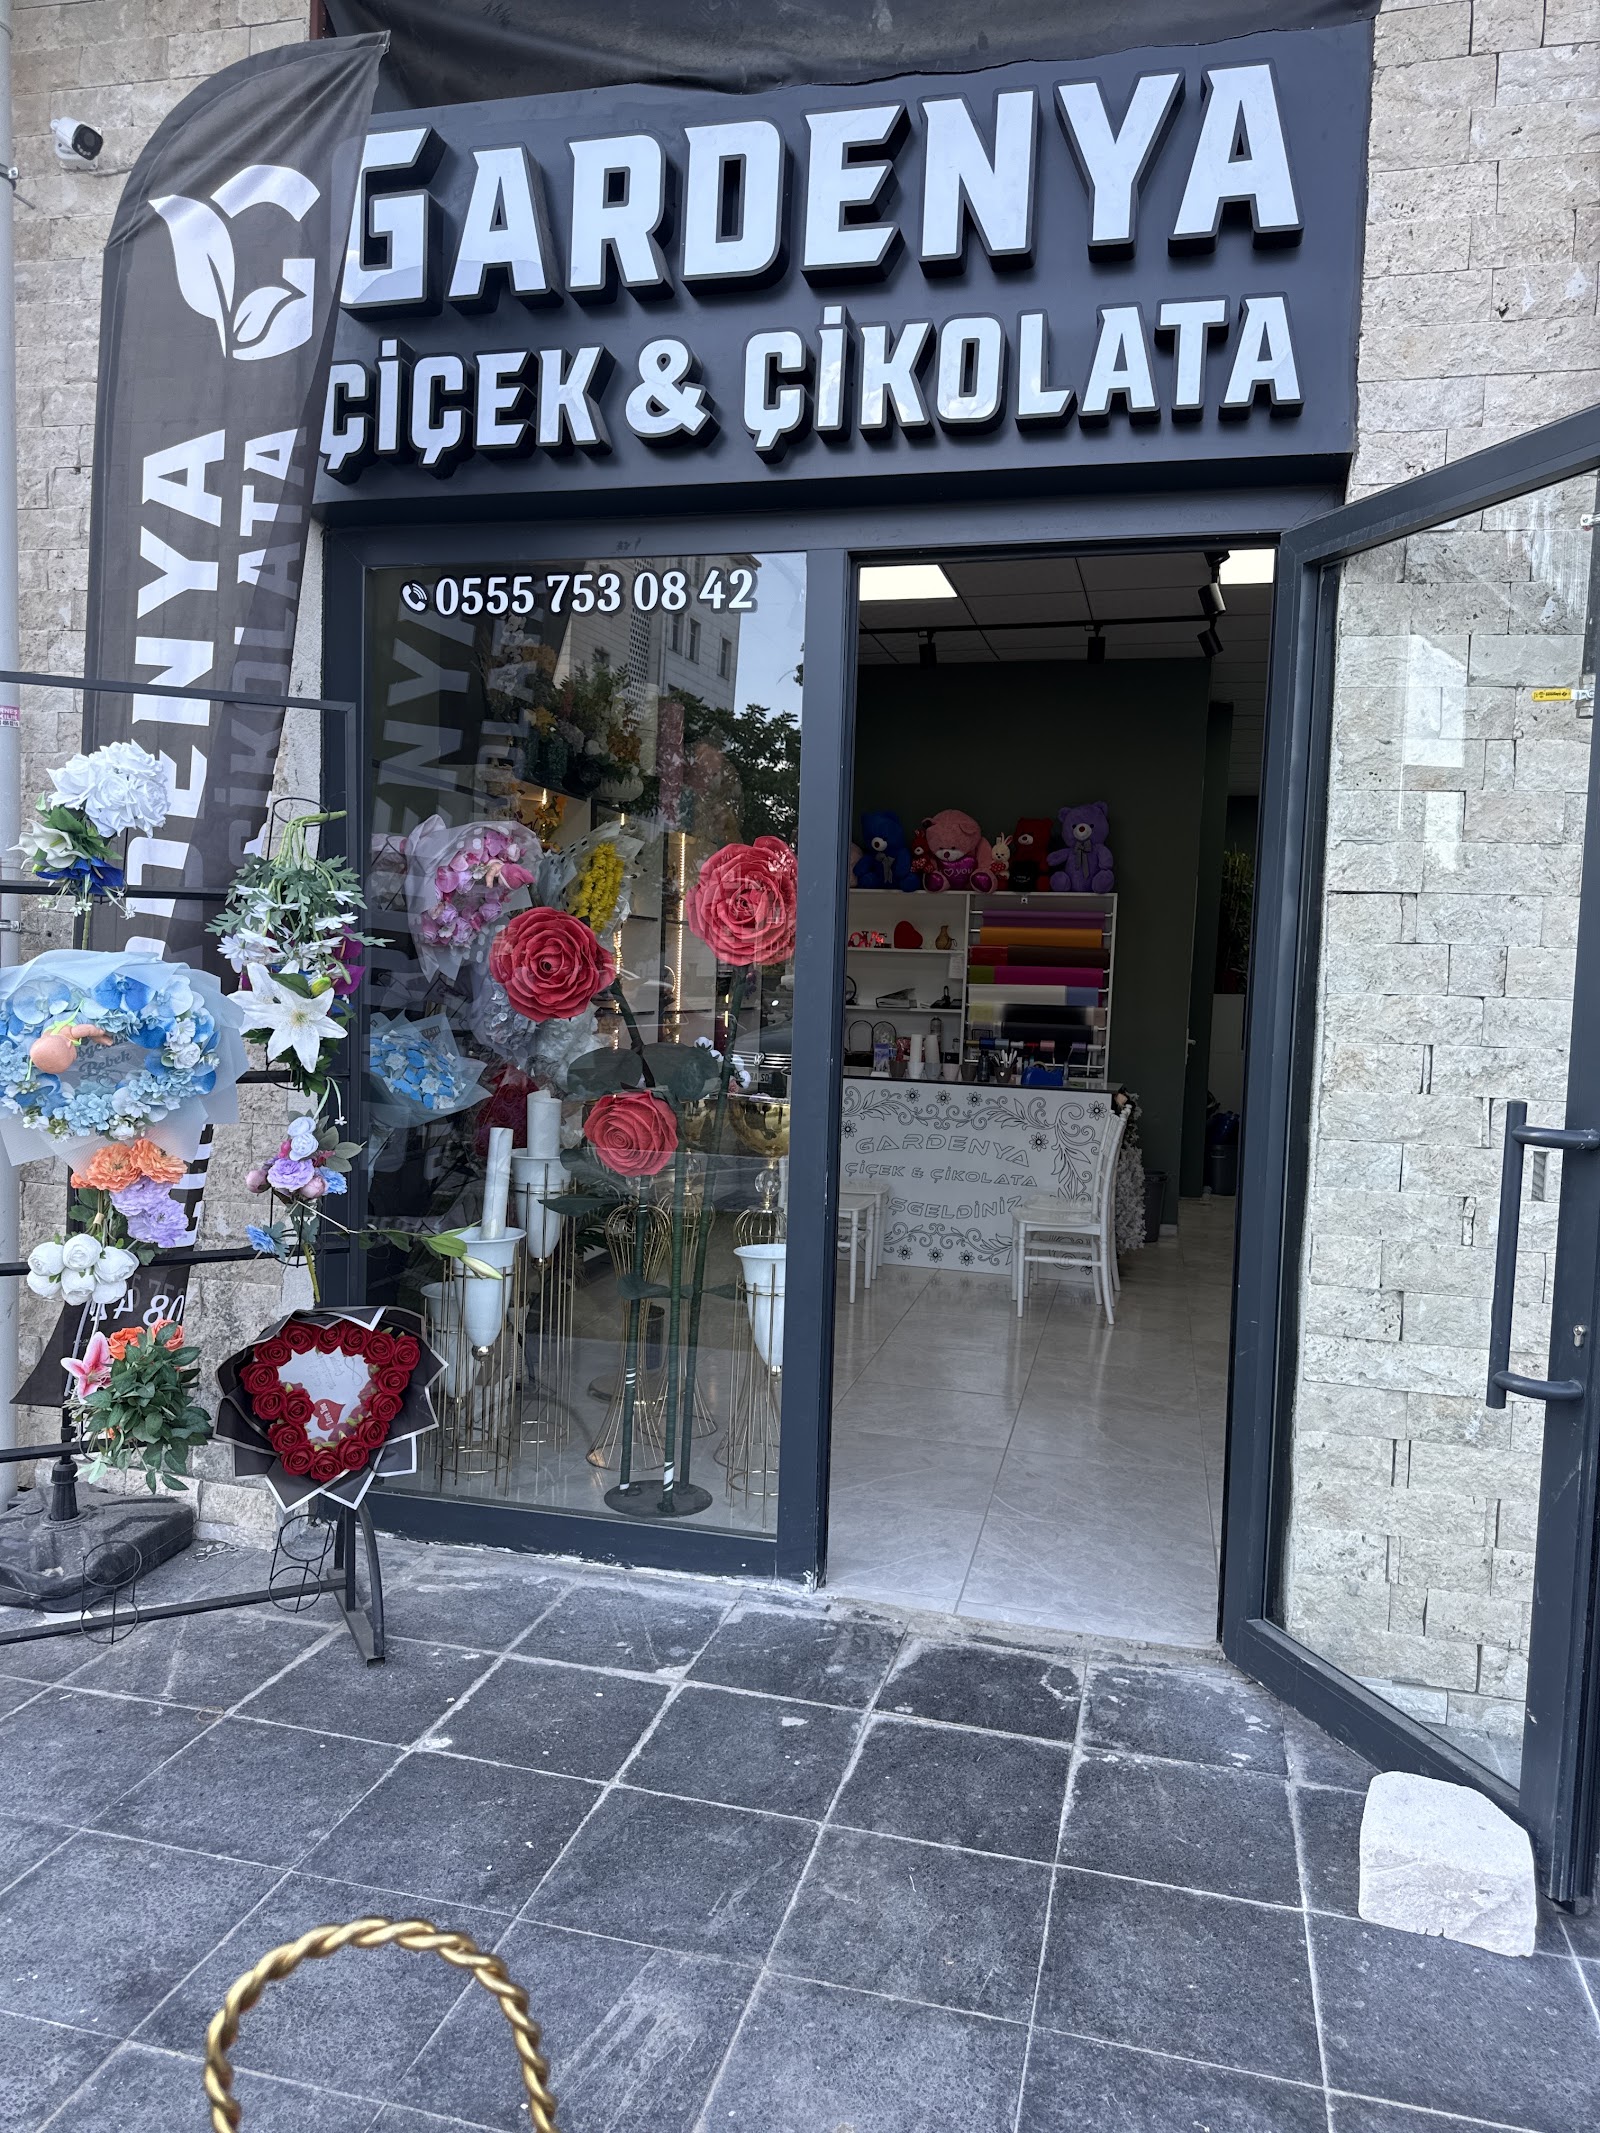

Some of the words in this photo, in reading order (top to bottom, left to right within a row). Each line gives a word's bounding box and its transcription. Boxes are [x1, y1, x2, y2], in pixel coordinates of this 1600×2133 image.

[338, 62, 1302, 307] GARDENYA
[319, 338, 603, 472] ÇİÇEK
[624, 337, 710, 438] &
[743, 295, 1302, 449] ÇİKOLATA
[434, 574, 536, 617] 0555
[546, 572, 622, 615] 753
[633, 569, 688, 613] 08
[698, 567, 755, 611] 42
[78, 1050, 132, 1080] Bebek
[855, 1133, 1030, 1168] GARDENYA
[845, 1159, 906, 1178] ÇİÇEK
[911, 1166, 925, 1179] &
[929, 1165, 1038, 1188] ÇİKOLATA
[885, 1194, 1023, 1220] ŞGELDİNİZ
